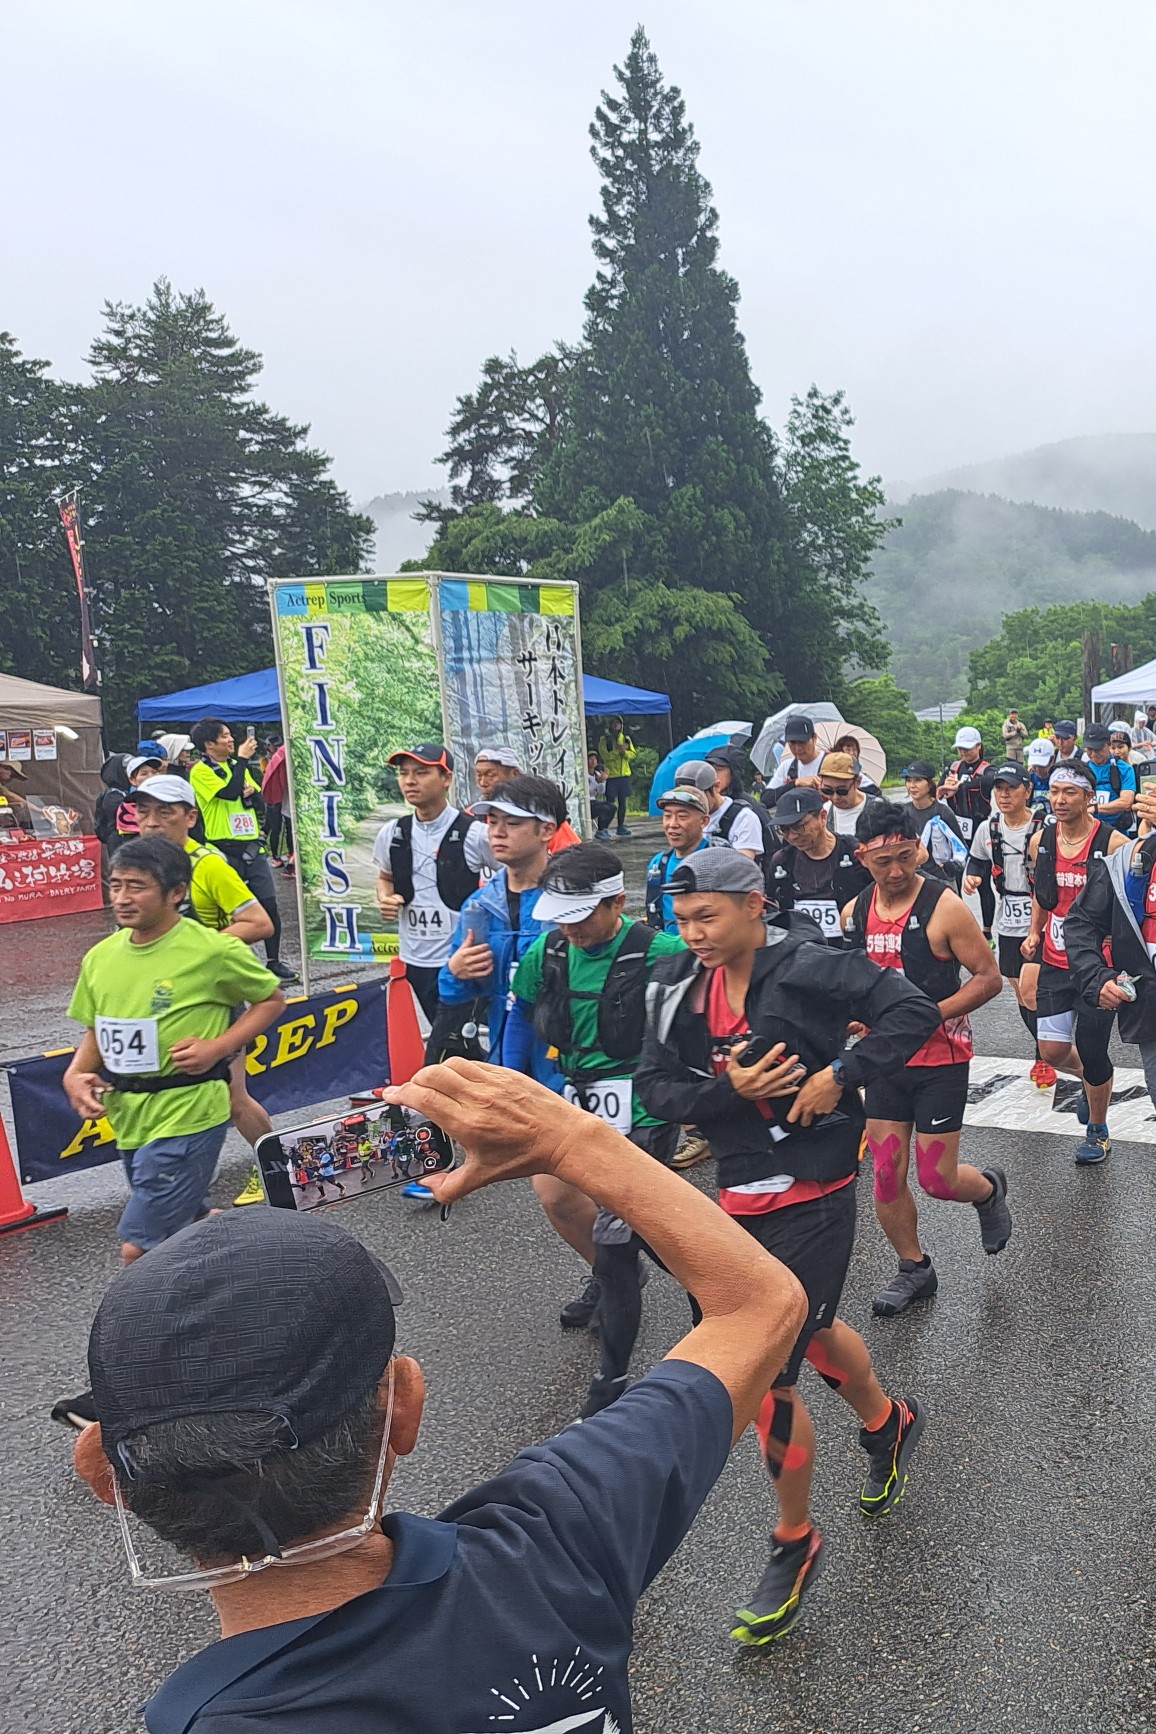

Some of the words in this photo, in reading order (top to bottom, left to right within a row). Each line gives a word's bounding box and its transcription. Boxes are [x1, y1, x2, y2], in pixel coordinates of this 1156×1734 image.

[286, 594, 325, 609] Actrep
[329, 590, 366, 608] Sports
[299, 623, 362, 952] FINISH
[408, 909, 443, 928] 044
[1004, 901, 1032, 918] 055
[369, 939, 400, 953] Actre
[101, 1027, 146, 1056] 054
